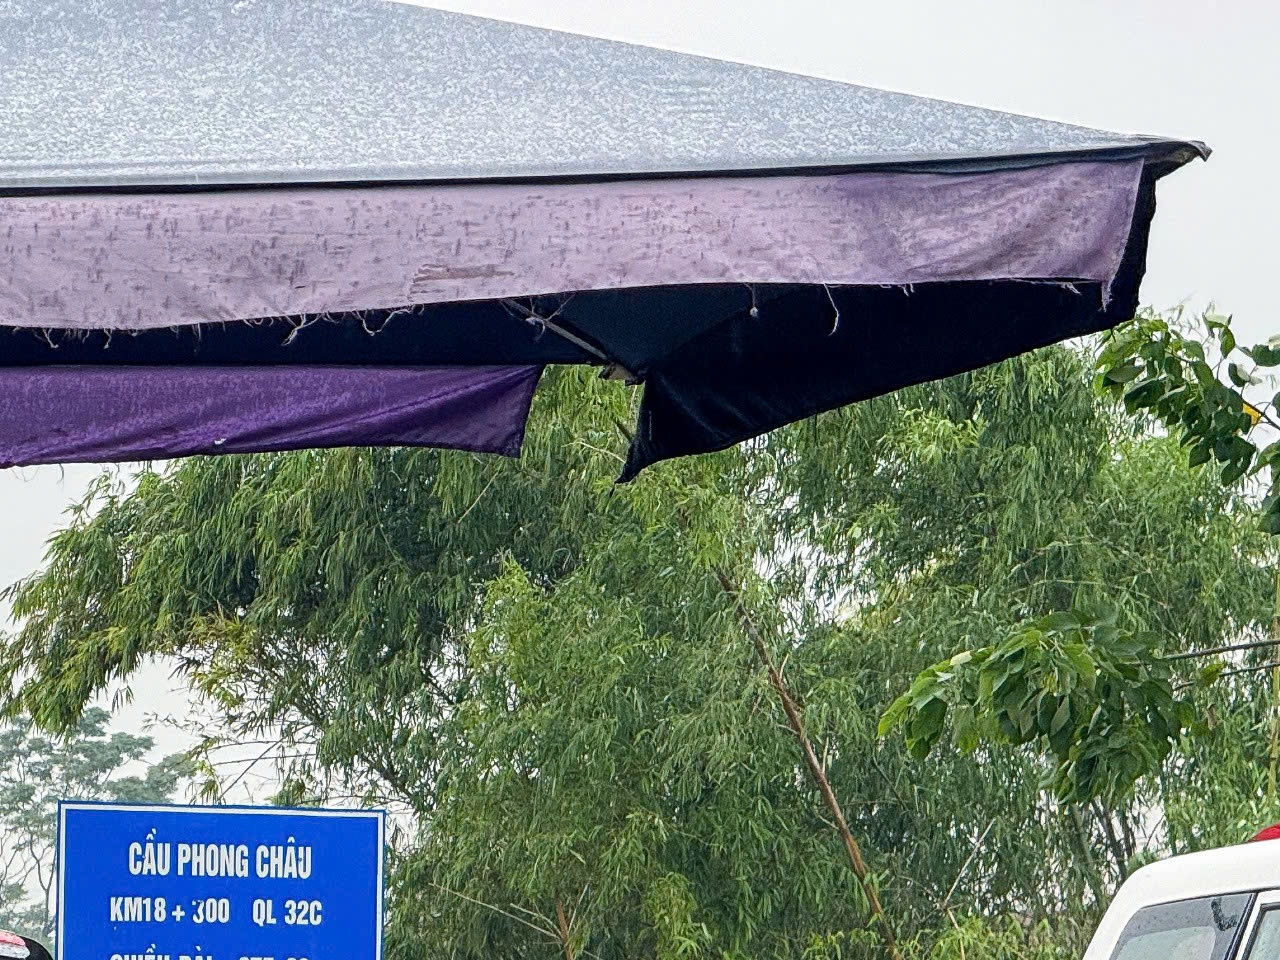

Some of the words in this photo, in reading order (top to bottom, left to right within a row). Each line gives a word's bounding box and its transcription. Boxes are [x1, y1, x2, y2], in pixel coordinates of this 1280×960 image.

[128, 828, 170, 876] CẦU
[177, 844, 249, 877] PHONG
[255, 837, 312, 879] CHÂU
[110, 897, 166, 922] KM18
[172, 905, 185, 922] +
[192, 898, 230, 923] 300
[252, 899, 277, 926] QL
[284, 900, 322, 925] 32C
